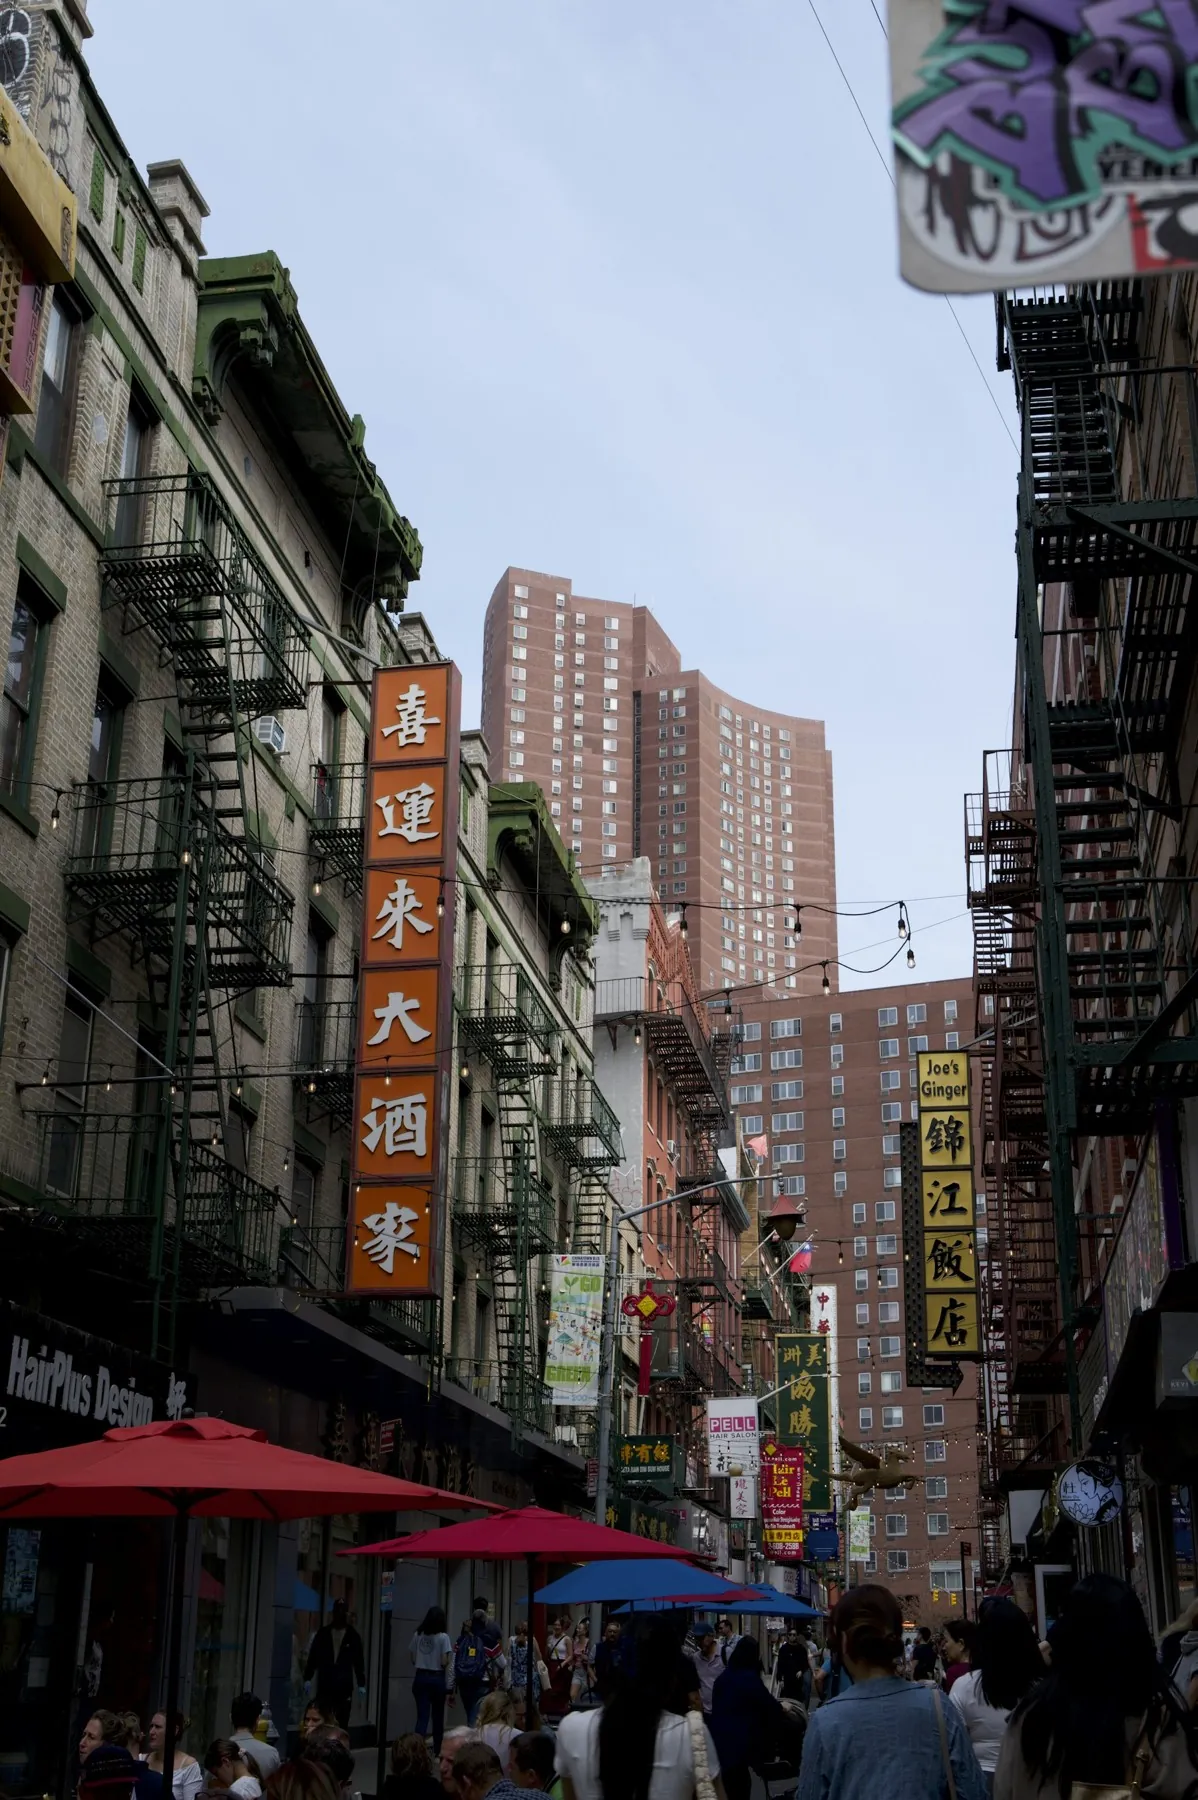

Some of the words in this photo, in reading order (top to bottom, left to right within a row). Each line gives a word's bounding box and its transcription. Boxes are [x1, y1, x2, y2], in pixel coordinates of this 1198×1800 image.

[362, 682, 442, 1275] 喜運來大酒家
[926, 1059, 959, 1077] Joe's
[920, 1080, 967, 1099] Ginger
[924, 1114, 973, 1349] 錦江飯店
[580, 1275, 602, 1293] GO
[6, 1334, 93, 1418] HairPlus
[711, 1417, 755, 1432] PELL
